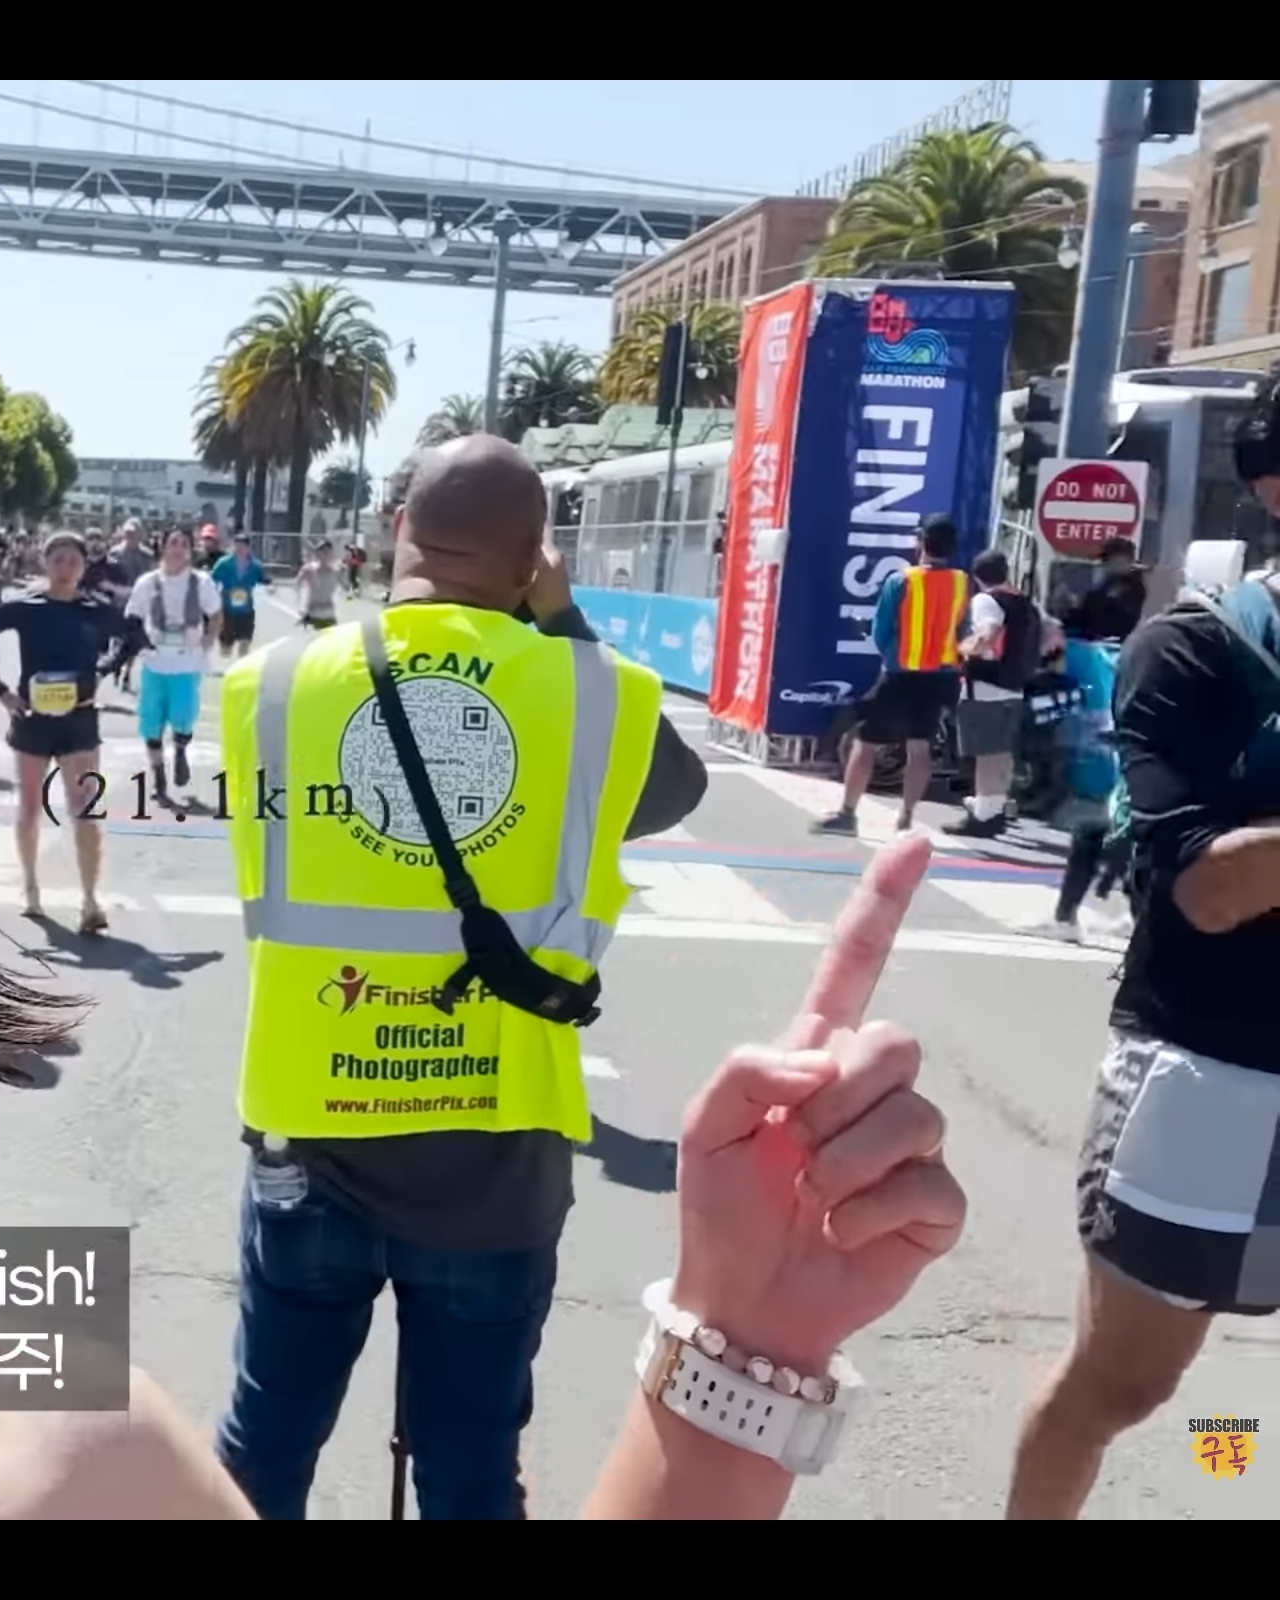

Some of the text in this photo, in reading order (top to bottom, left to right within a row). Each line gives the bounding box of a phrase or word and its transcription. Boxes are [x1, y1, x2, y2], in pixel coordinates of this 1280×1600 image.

[860, 373, 946, 389] MARATHON
[1055, 481, 1127, 499] DO NOT
[1055, 523, 1118, 541] ENTER
[387, 652, 494, 685] SCAN
[350, 824, 387, 856] SEE
[392, 848, 436, 868] YOU
[457, 801, 527, 860] PHOTOS
[375, 1023, 465, 1050] Official
[330, 1053, 499, 1082] Photographer
